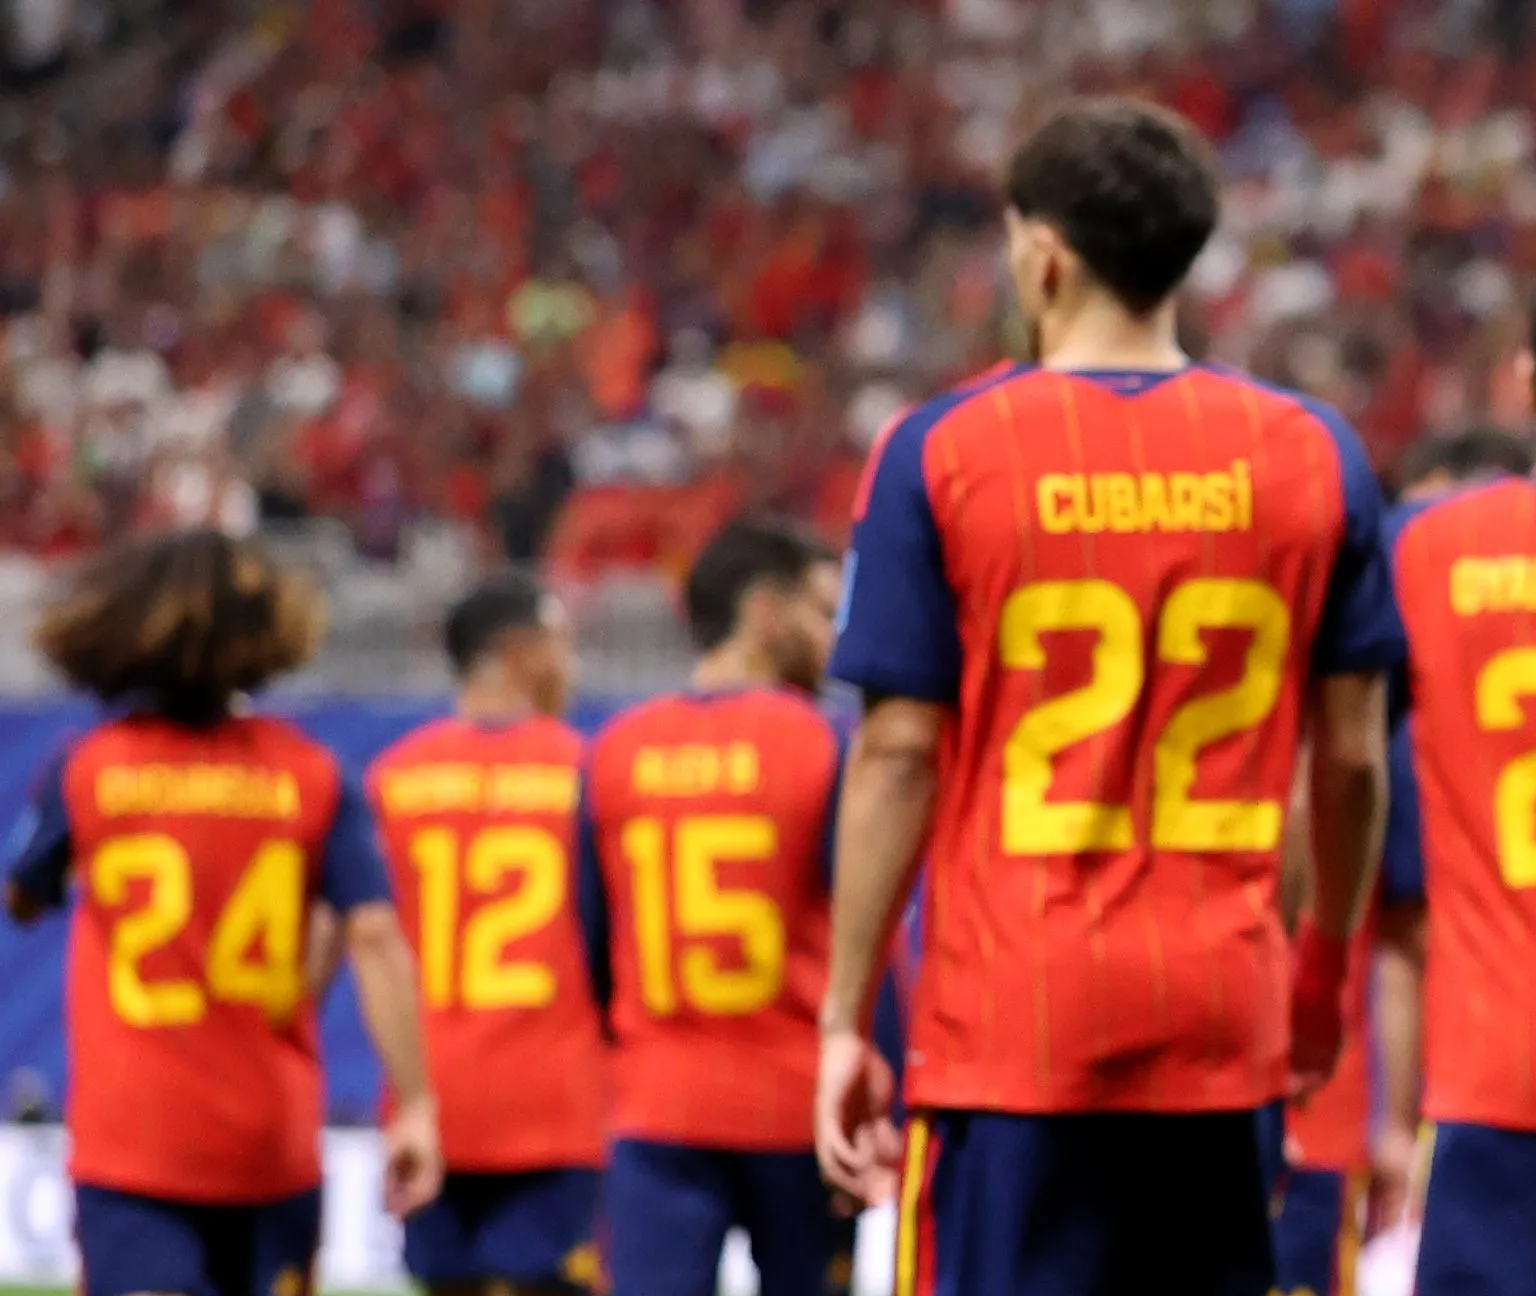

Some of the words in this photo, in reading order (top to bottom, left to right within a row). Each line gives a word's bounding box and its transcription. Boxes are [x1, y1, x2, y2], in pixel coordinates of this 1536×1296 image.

[1036, 458, 1251, 534] CUBARSÍ
[1001, 578, 1290, 856] 22
[92, 832, 308, 1028] 24
[409, 825, 568, 1010] 12
[621, 815, 786, 1016] 15
